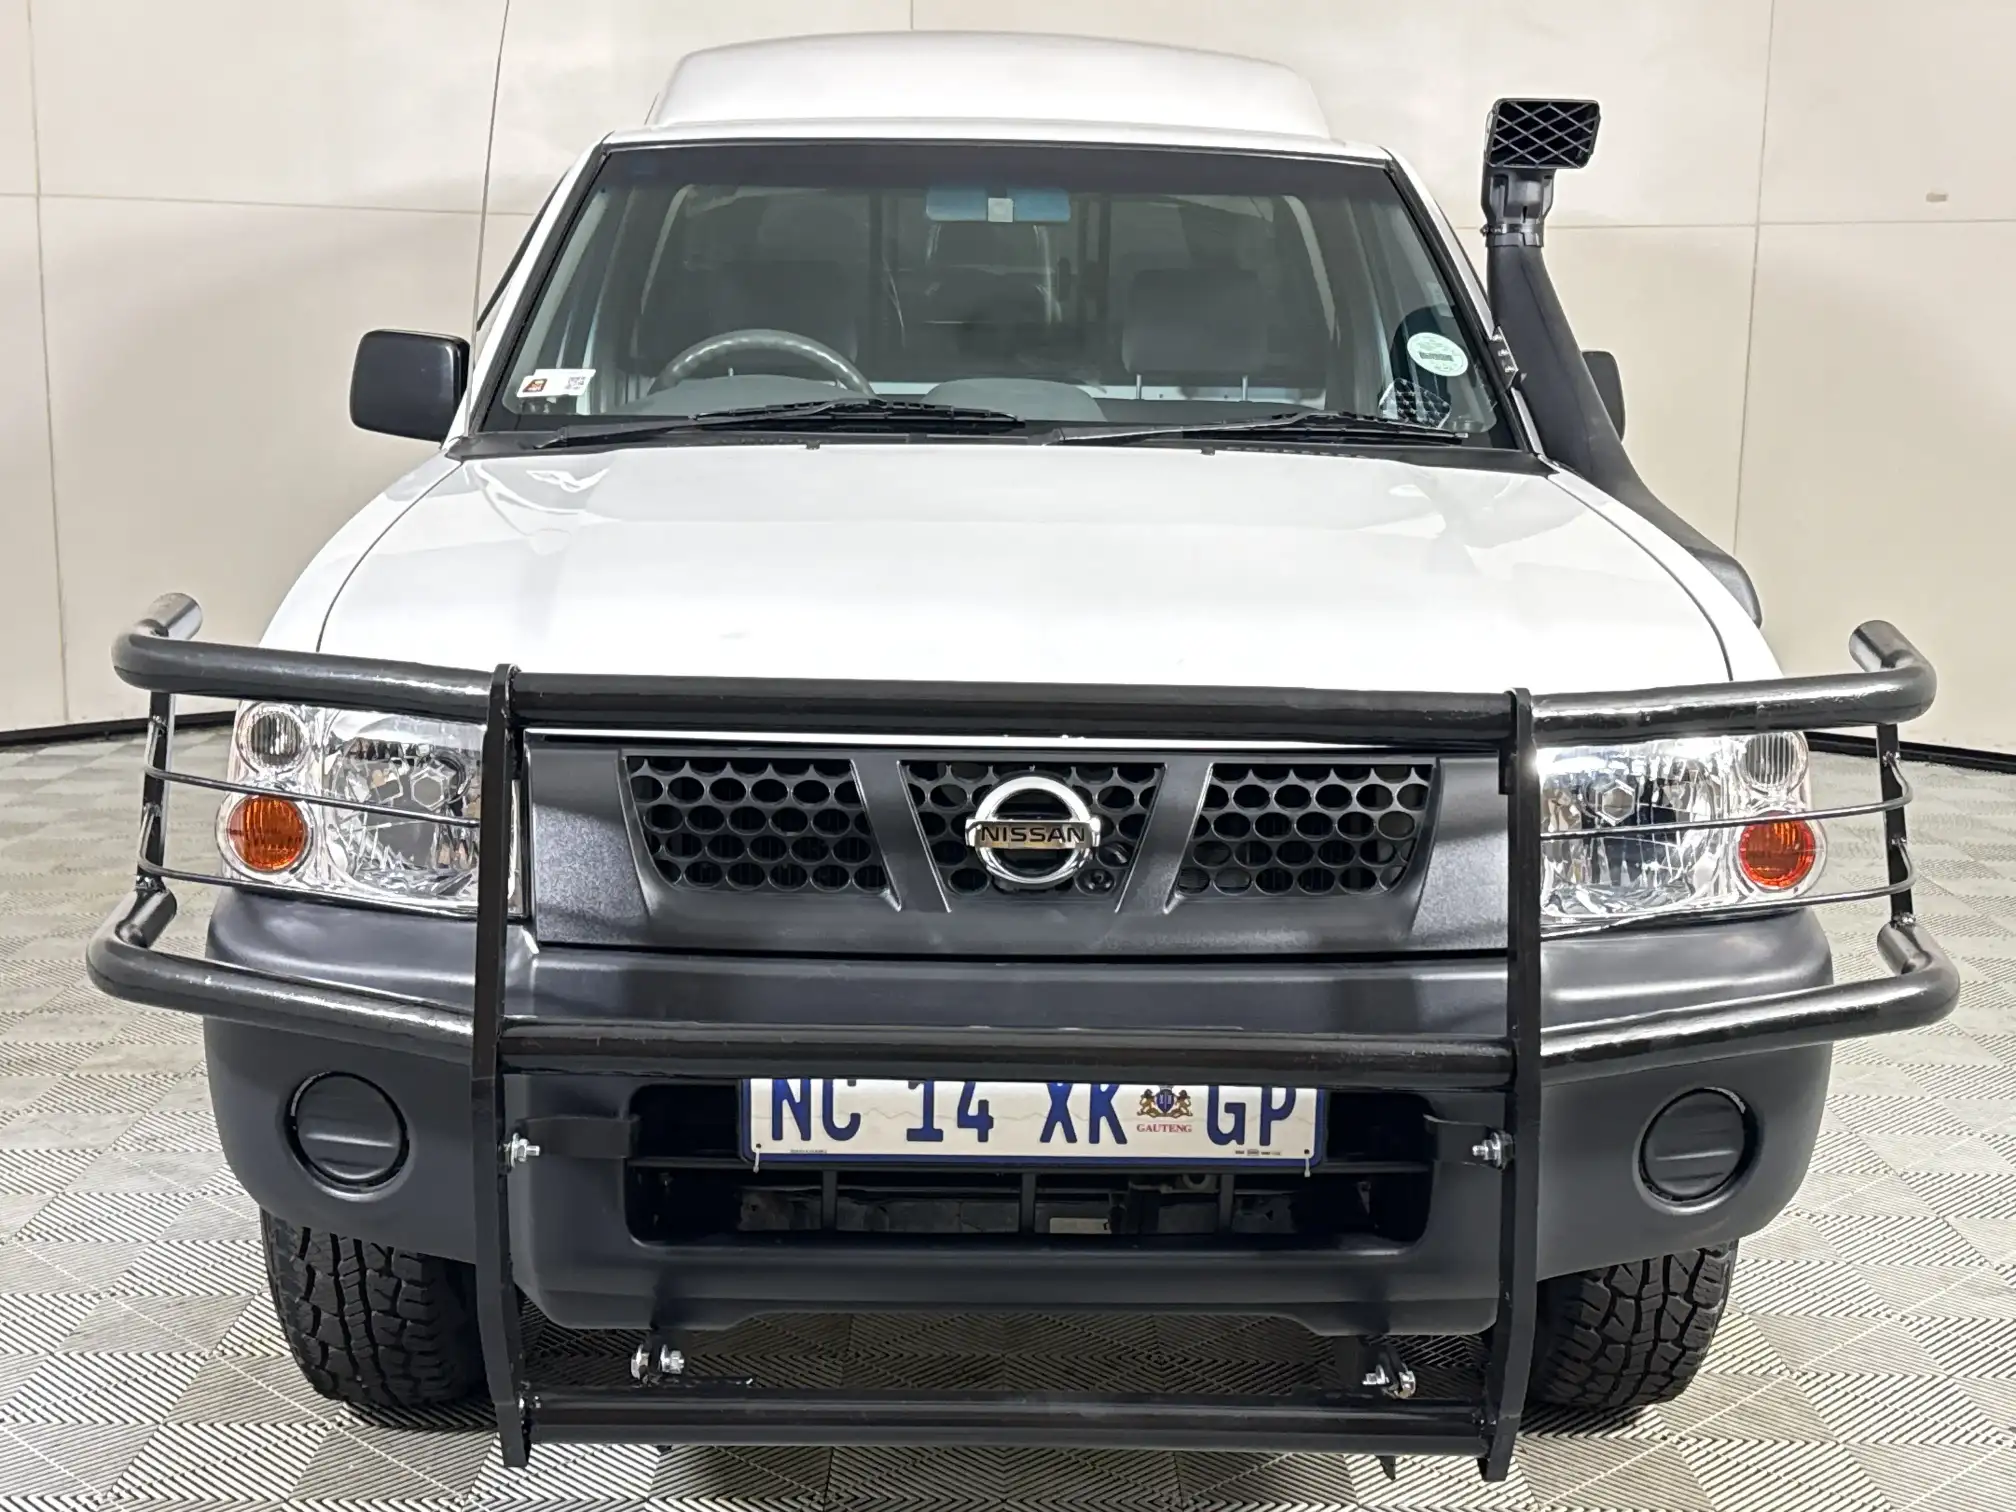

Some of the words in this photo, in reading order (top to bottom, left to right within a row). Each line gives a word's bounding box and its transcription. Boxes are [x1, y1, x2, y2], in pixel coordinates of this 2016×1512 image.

[980, 826, 1085, 843] NISSAN
[771, 1078, 861, 1142] NC
[906, 1081, 994, 1143] 14
[1039, 1083, 1128, 1145] XK
[1206, 1085, 1297, 1147] GP
[1136, 1123, 1193, 1134] GAUTENG
